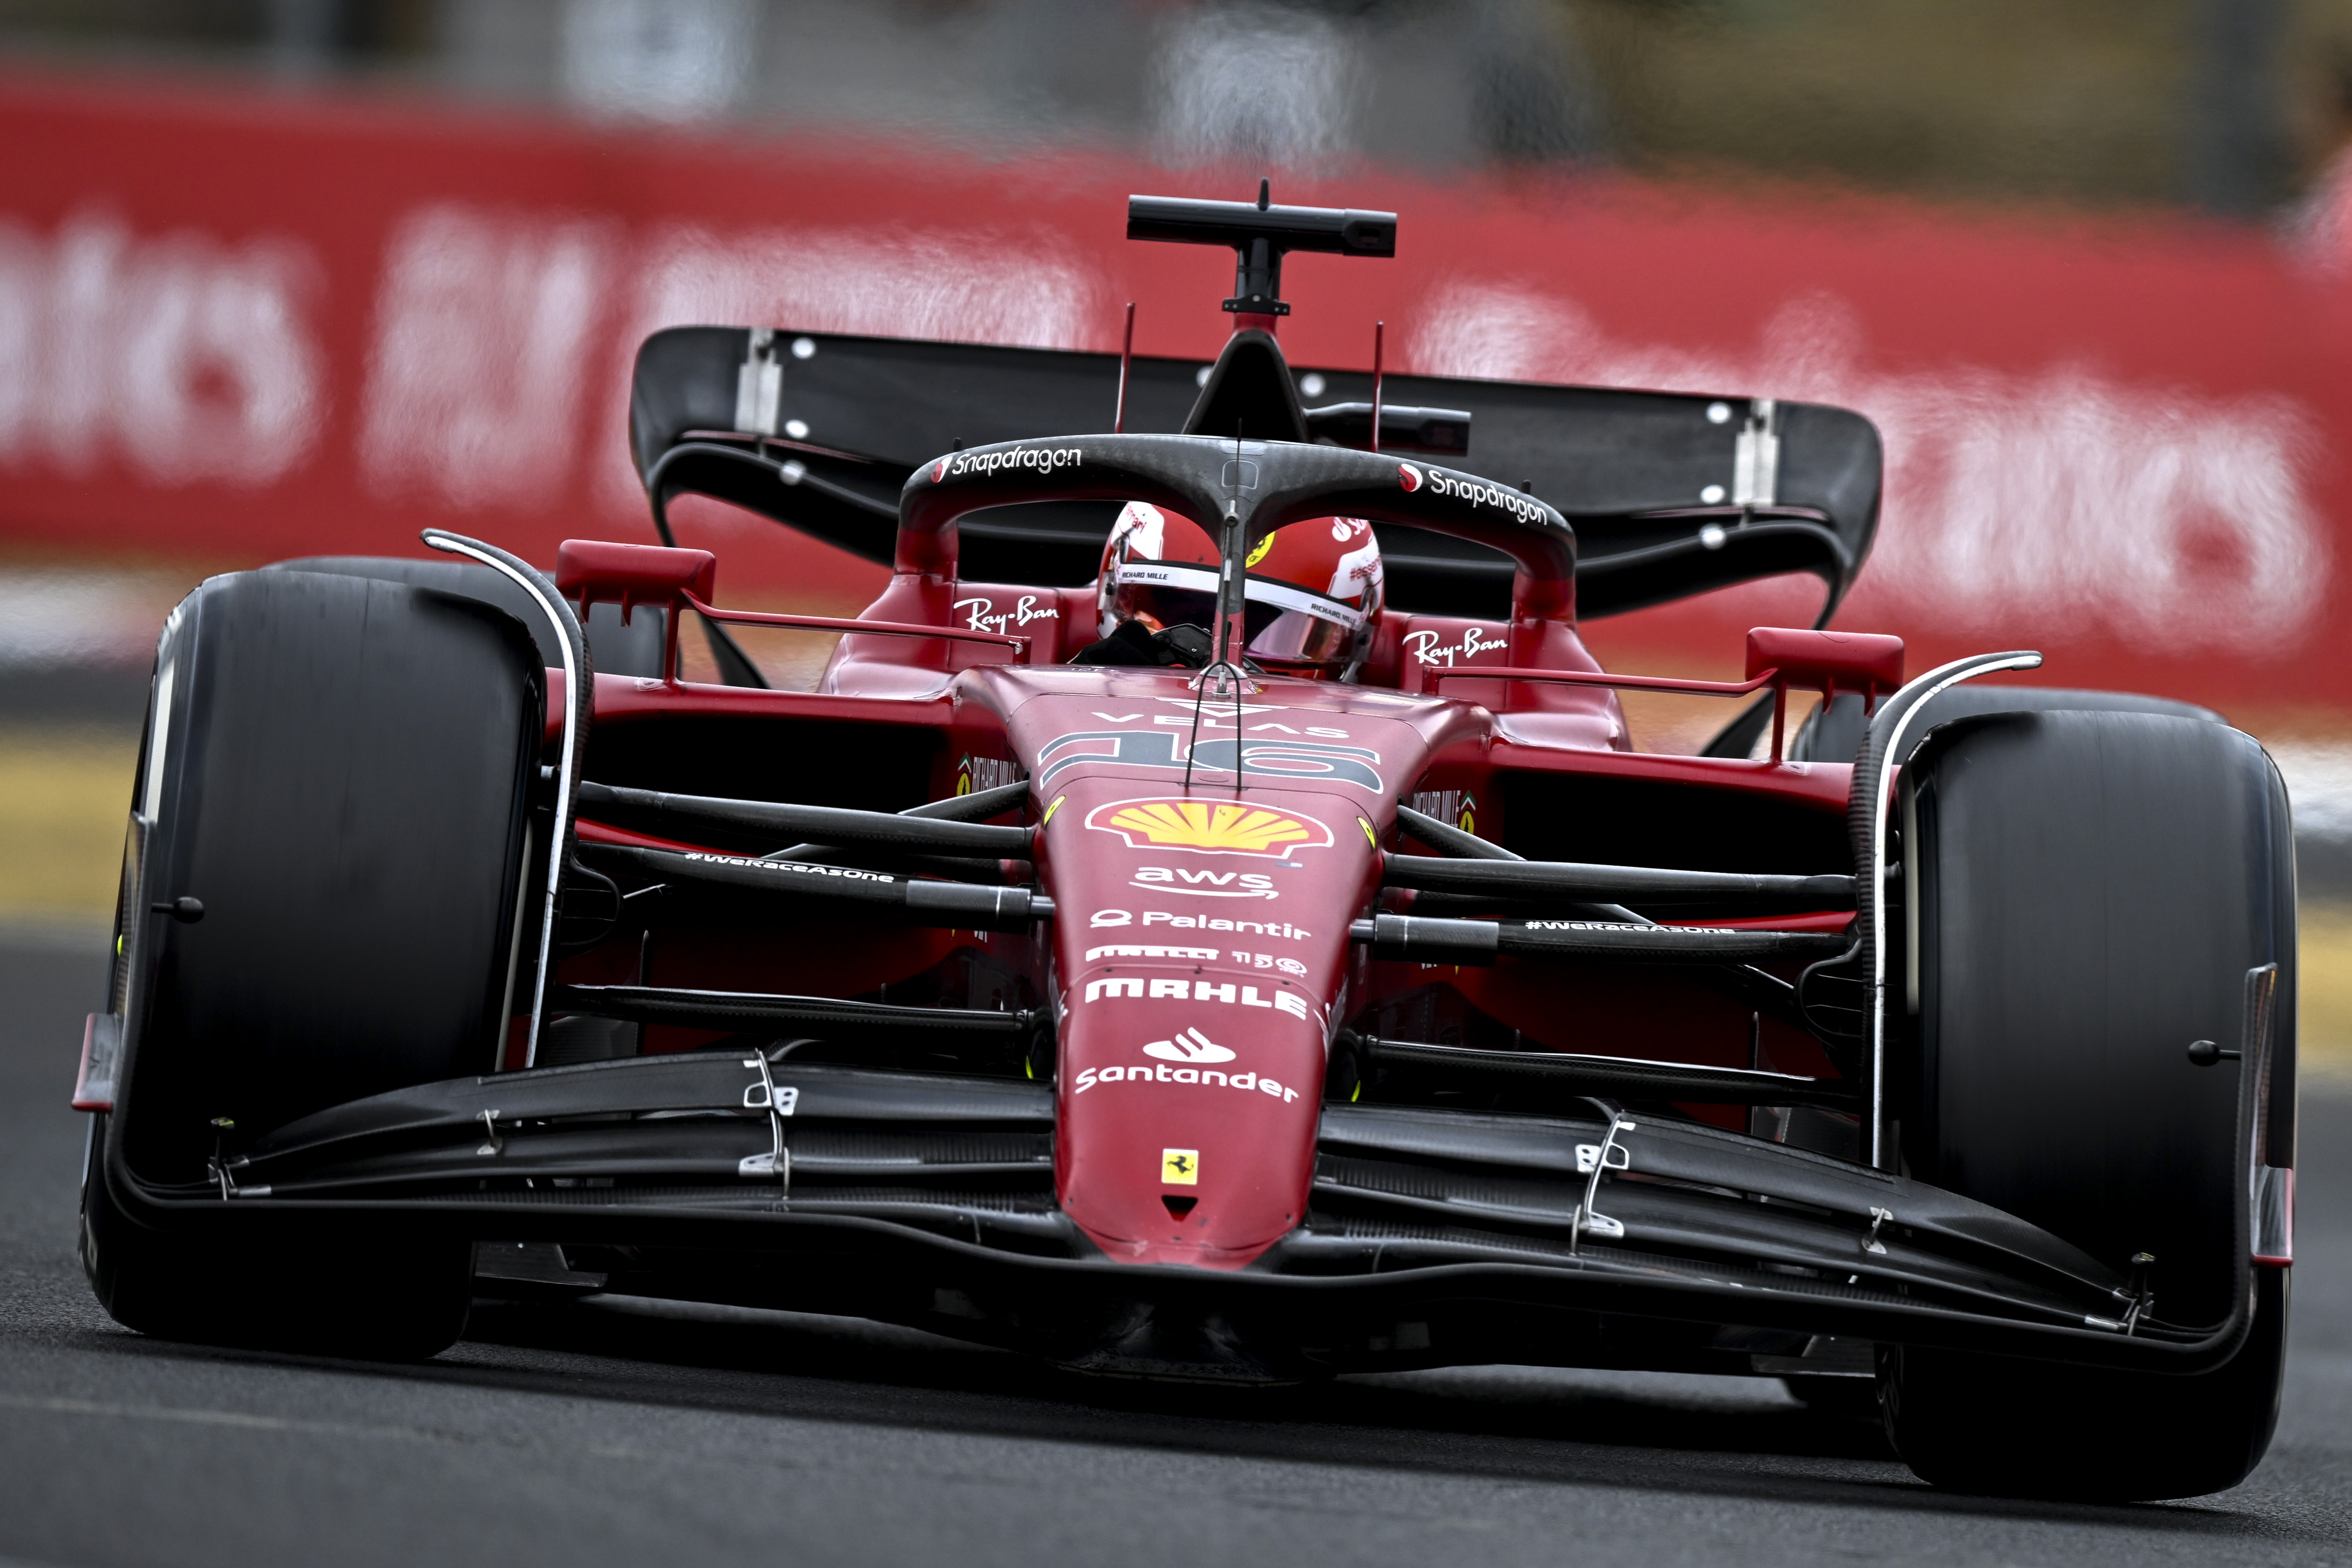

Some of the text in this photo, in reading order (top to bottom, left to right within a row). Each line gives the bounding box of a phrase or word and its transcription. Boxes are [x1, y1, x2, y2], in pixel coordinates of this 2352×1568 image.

[952, 446, 1081, 476] Snapdragon
[1429, 470, 1547, 525] Snapdragon
[953, 595, 1060, 635] Ray-Ban
[1311, 603, 1341, 619] RICHARD
[1402, 628, 1508, 667] Ray-Ban
[1091, 712, 1349, 738] VELAS
[1038, 730, 1383, 794] 16
[685, 853, 894, 883] #WeRaceAsOne
[1135, 867, 1274, 889] aws
[1143, 911, 1311, 940] Palantir
[1525, 921, 1736, 934] #WeRaceAsOne
[1085, 978, 1307, 1020] MAHLE
[1075, 1064, 1299, 1103] Santander
